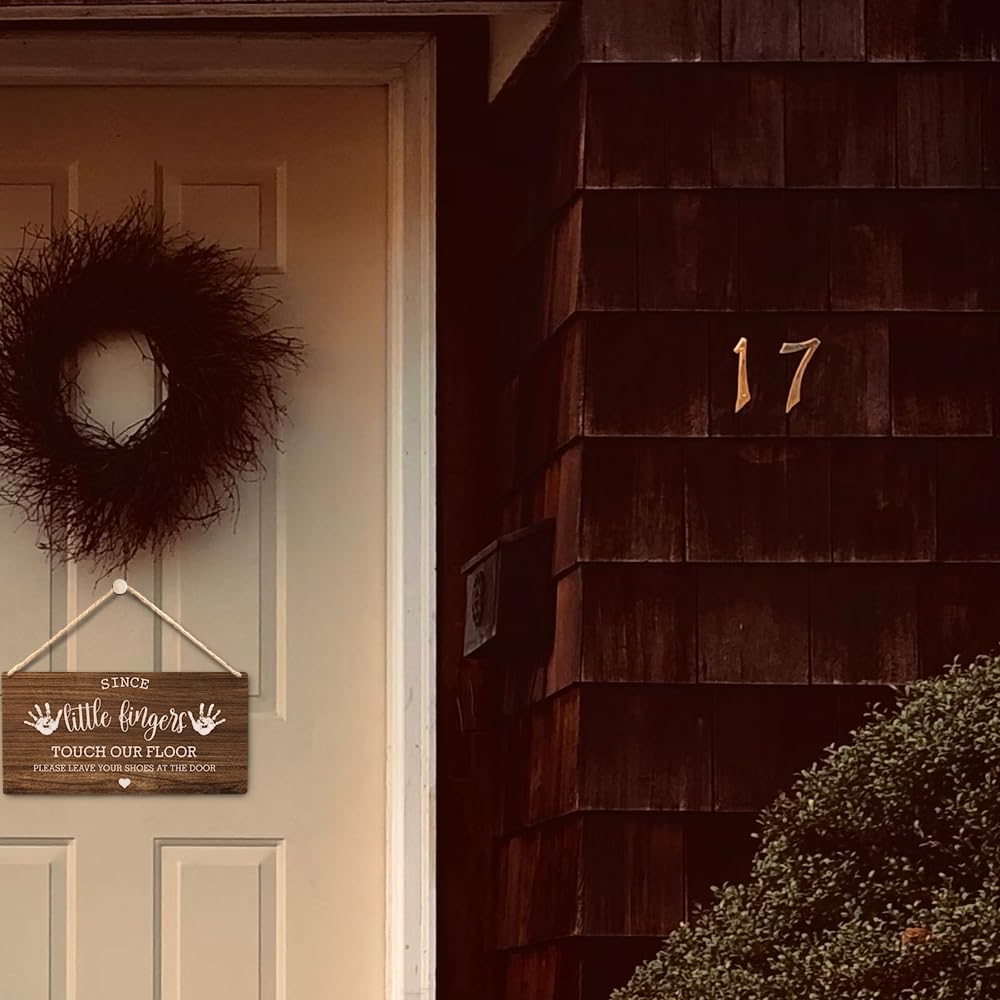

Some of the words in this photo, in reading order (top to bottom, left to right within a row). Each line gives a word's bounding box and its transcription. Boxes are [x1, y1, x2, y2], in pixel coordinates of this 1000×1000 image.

[733, 337, 821, 414] 17
[100, 677, 150, 690] SINCE
[63, 698, 112, 733] little
[118, 700, 188, 742] fingers
[51, 745, 106, 758] TOUCH
[110, 745, 143, 758] OUR
[146, 745, 198, 758] FLOOR
[33, 764, 66, 772] PLEASE
[68, 764, 96, 772] LEAVE
[97, 764, 123, 772] YOUR
[125, 764, 155, 772] SHOES
[157, 764, 169, 772] AT
[170, 764, 187, 772] THE
[189, 764, 216, 772] DOOR
